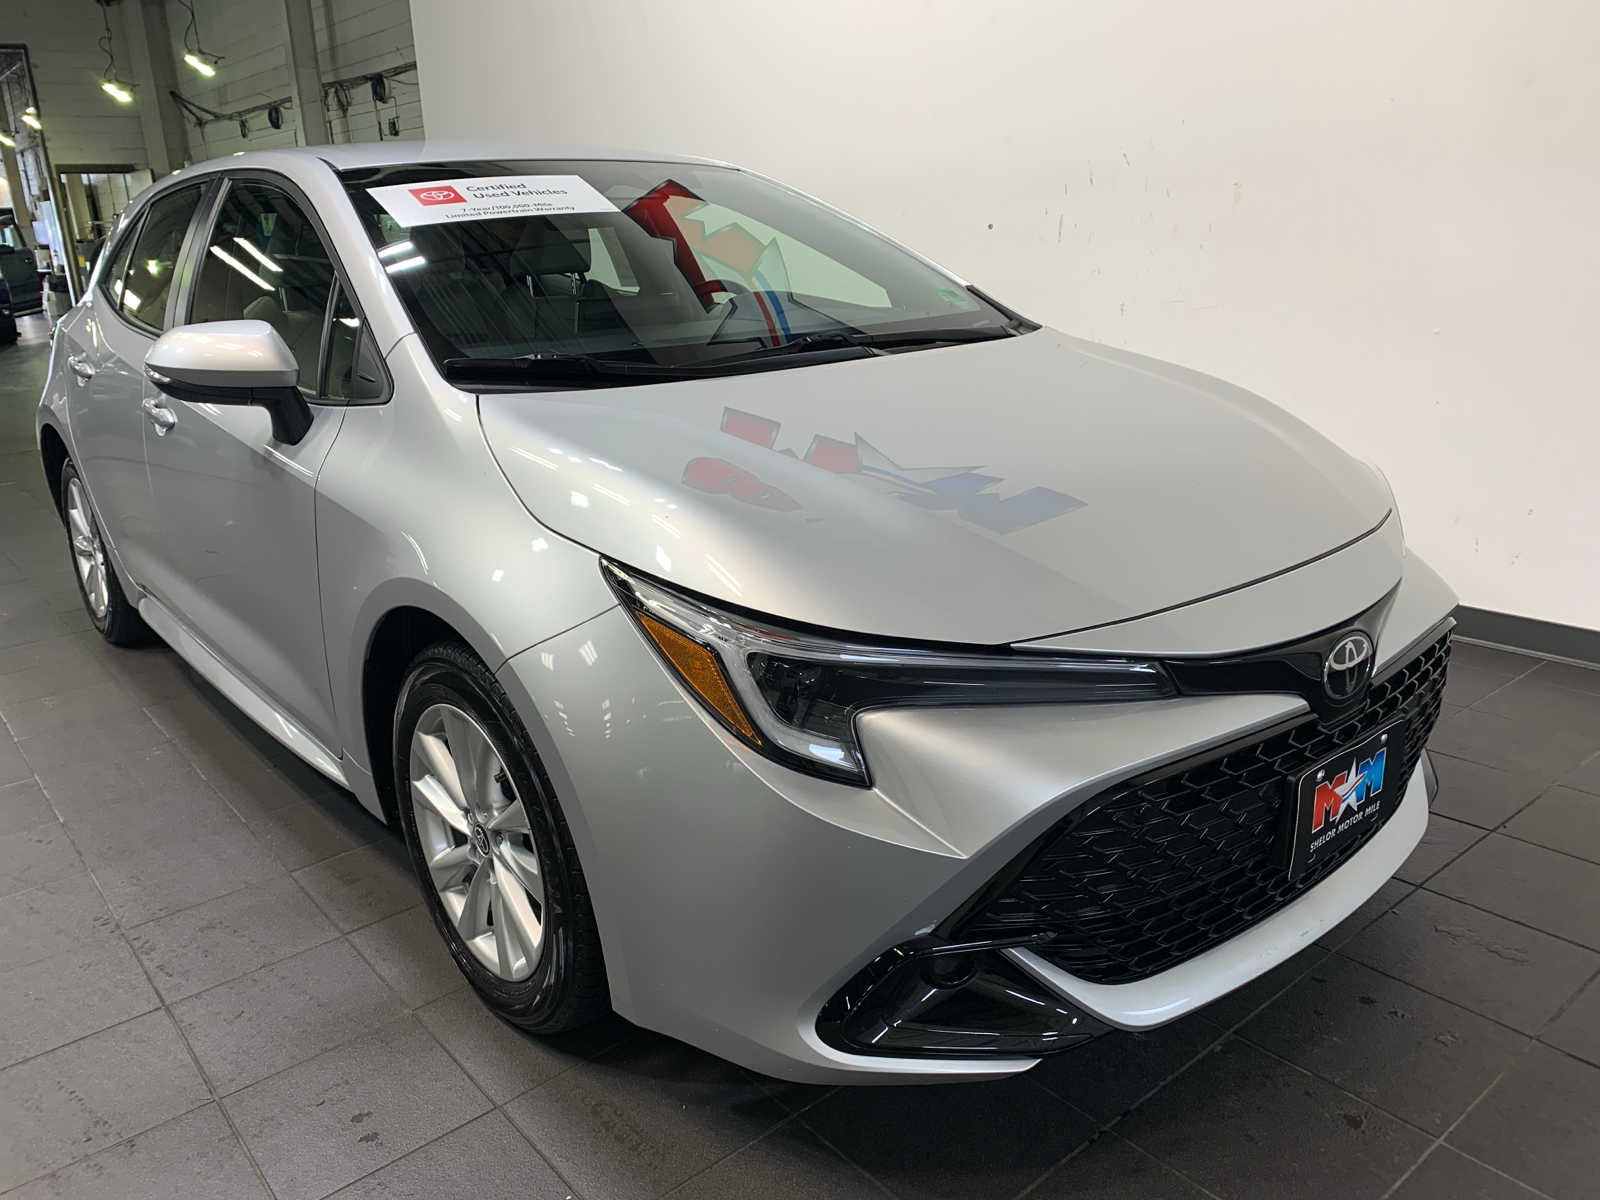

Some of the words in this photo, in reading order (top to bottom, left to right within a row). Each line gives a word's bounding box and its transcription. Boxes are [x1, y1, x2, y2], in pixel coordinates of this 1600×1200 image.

[466, 183, 526, 192] Certified
[473, 191, 510, 199] Used
[511, 189, 568, 197] Vehicles
[1310, 827, 1337, 853] SHELOR
[1337, 811, 1363, 835] MOTOR
[1364, 800, 1381, 818] MILE
